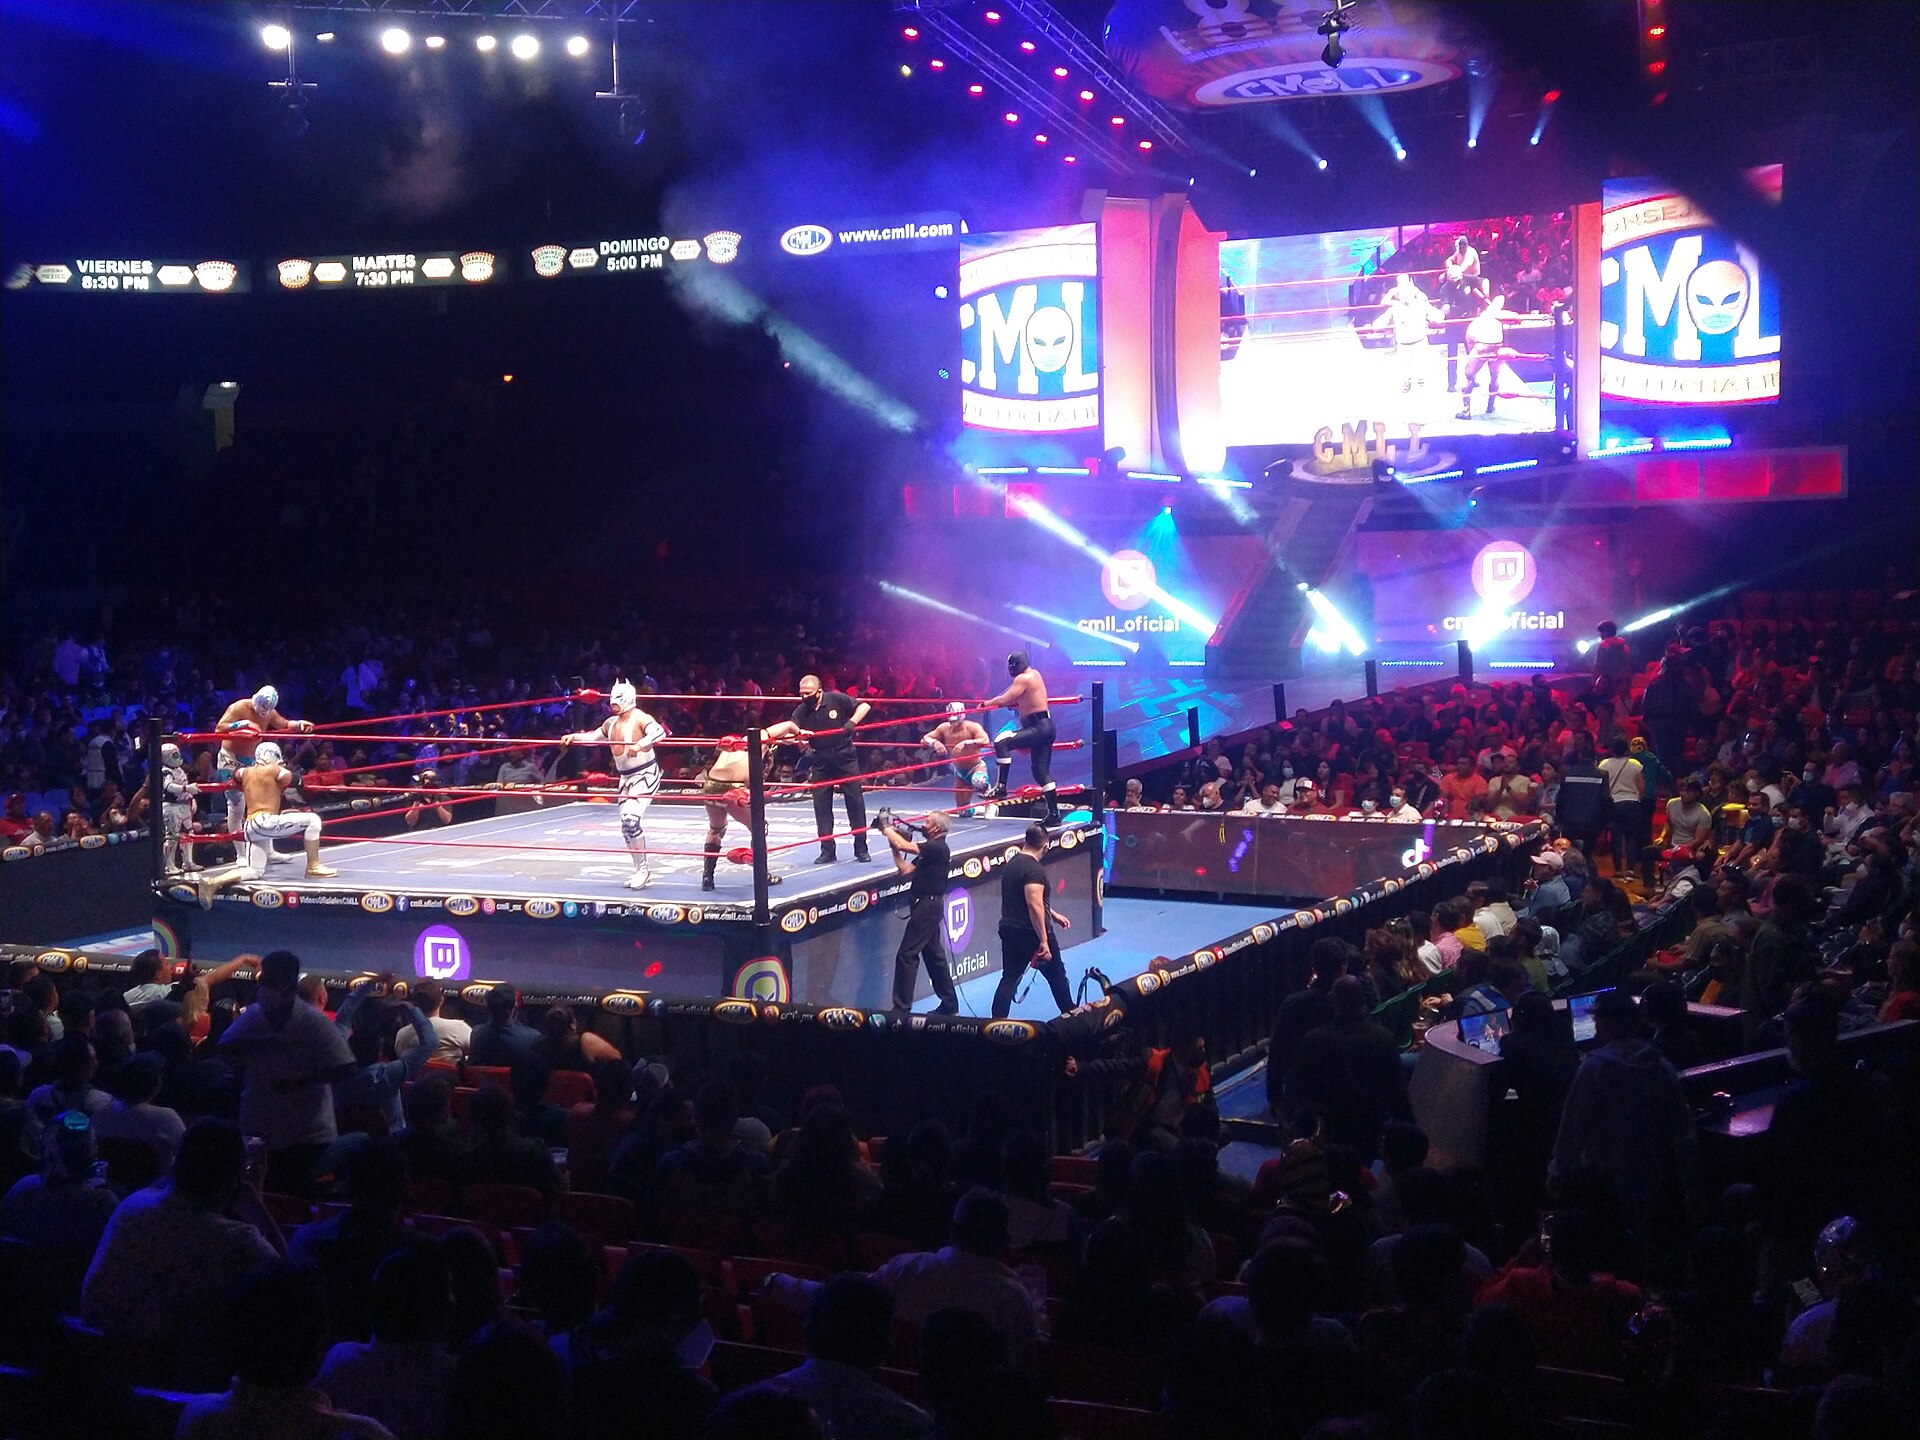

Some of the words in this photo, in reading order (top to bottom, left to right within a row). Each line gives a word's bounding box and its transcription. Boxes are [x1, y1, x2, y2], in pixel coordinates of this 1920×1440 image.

[839, 223, 952, 243] www.cmll.com
[600, 236, 670, 255] DOMINGO
[76, 259, 153, 274] VIERNES
[352, 255, 416, 270] MARTES
[607, 256, 637, 271] 5:00
[640, 254, 663, 269] PM
[81, 276, 118, 290] 8:30
[122, 276, 149, 290] PM
[355, 271, 387, 286] 7:30
[390, 270, 414, 285] PM
[1313, 420, 1430, 467] CMLL
[1076, 615, 1180, 633] cmll_oficial
